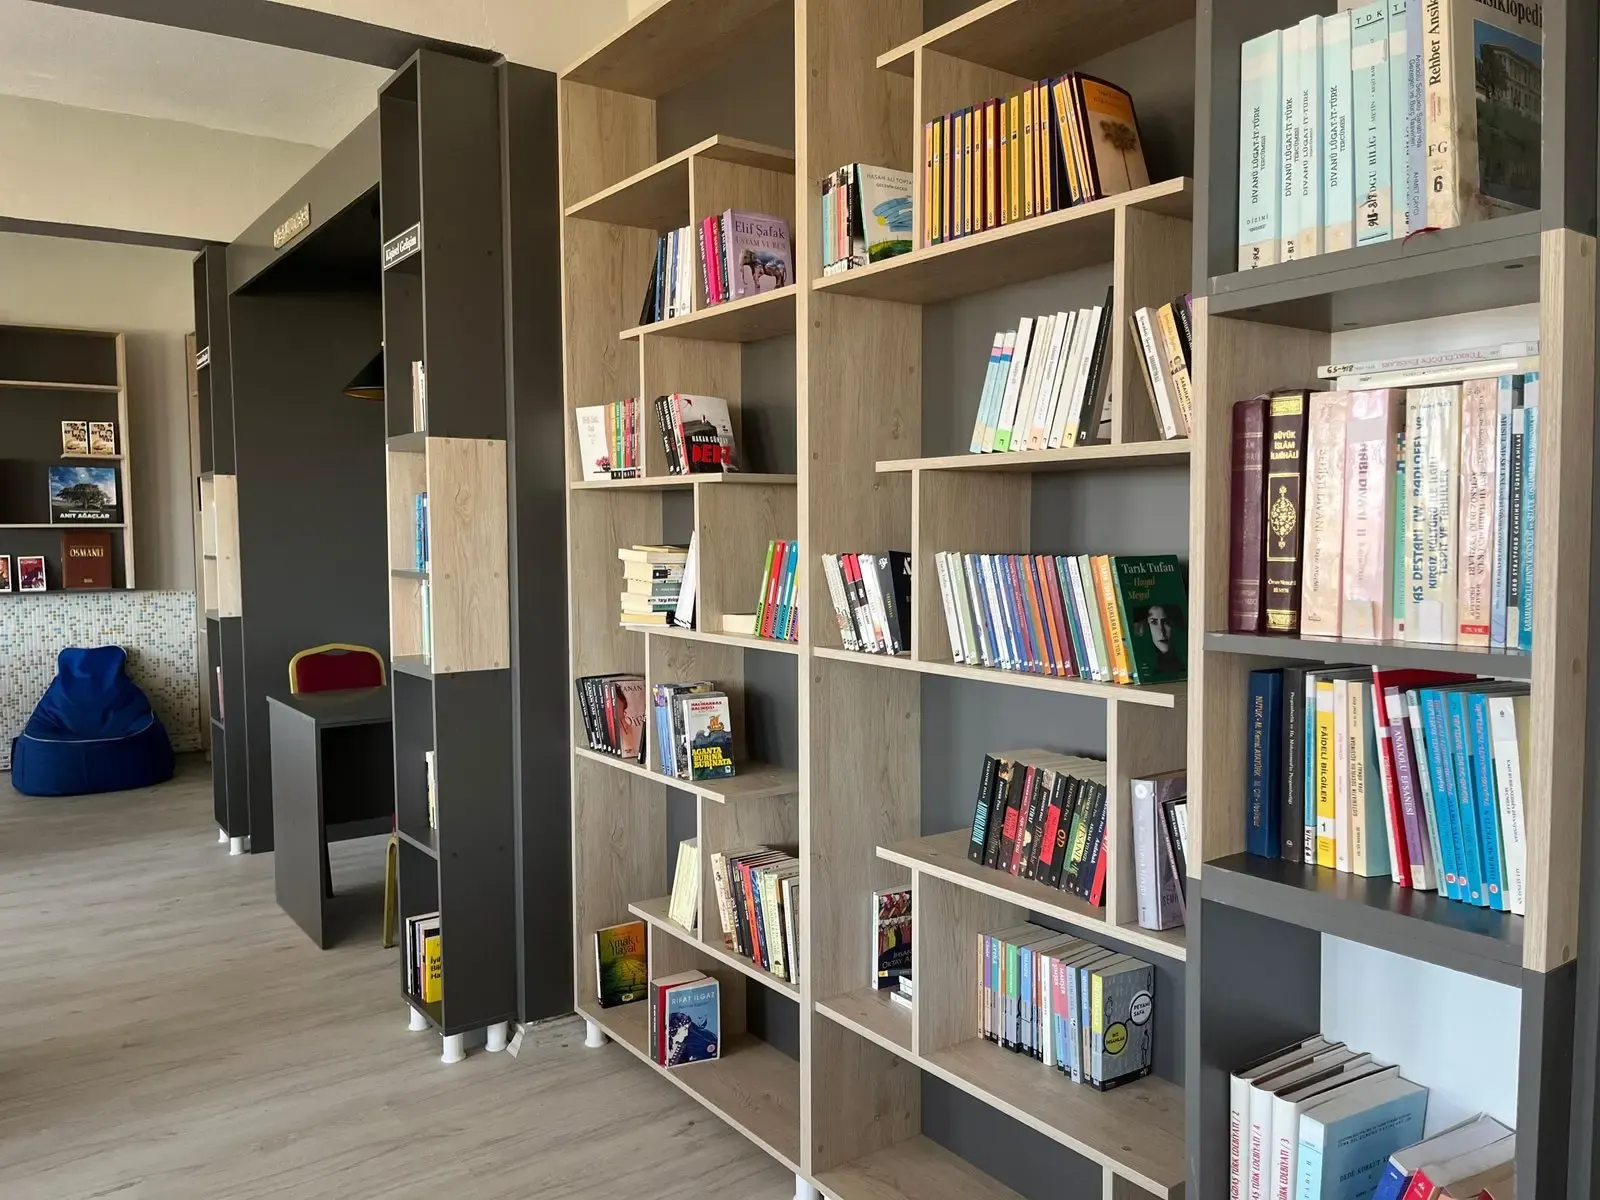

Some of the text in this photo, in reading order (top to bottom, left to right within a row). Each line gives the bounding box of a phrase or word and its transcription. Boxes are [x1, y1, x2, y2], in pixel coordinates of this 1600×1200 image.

[1475, 0, 1543, 28] siklopedi
[1428, 40, 1441, 86] Rehber
[1367, 136, 1377, 166] BİLİG
[1428, 141, 1448, 157] FG
[896, 178, 913, 186] TOPTA
[1433, 176, 1444, 193] 6
[735, 221, 786, 240] Elif Şafak
[400, 236, 417, 252] Gelişim
[1273, 430, 1296, 440] BÜYÜK
[78, 512, 110, 520] AĞAÇLAR
[1428, 506, 1438, 551] KÜLTÜRÜ
[70, 548, 104, 558] OSMANLI
[1412, 529, 1424, 580] DESTANI
[1439, 541, 1449, 575] TESPİT
[1122, 561, 1174, 574] Tarık Tufan
[1428, 555, 1438, 588] KIRGIZ
[692, 747, 722, 756] AGANTA
[1254, 748, 1262, 776] ATATÜRK
[1320, 762, 1328, 803] BİLGİLER
[1392, 731, 1414, 816] ANADOLU EFSANESİ
[1066, 782, 1075, 810] İSKENDER
[1057, 830, 1066, 848] OD
[882, 959, 902, 969] OKTAY
[671, 994, 692, 1005] RIFAT
[694, 991, 716, 1002] ILGAZ
[1133, 1002, 1150, 1011] PEYAMİ
[1133, 1010, 1145, 1018] SAFA
[1232, 1122, 1240, 1156] EDEBİYATI
[1252, 1136, 1260, 1170] EDEBİYATI
[1232, 1158, 1240, 1175] TÜRK
[1280, 1150, 1290, 1184] EDEBİYATI
[1340, 1160, 1381, 1182] DEDE KORKUT
[1252, 1172, 1260, 1190] TÜRK
